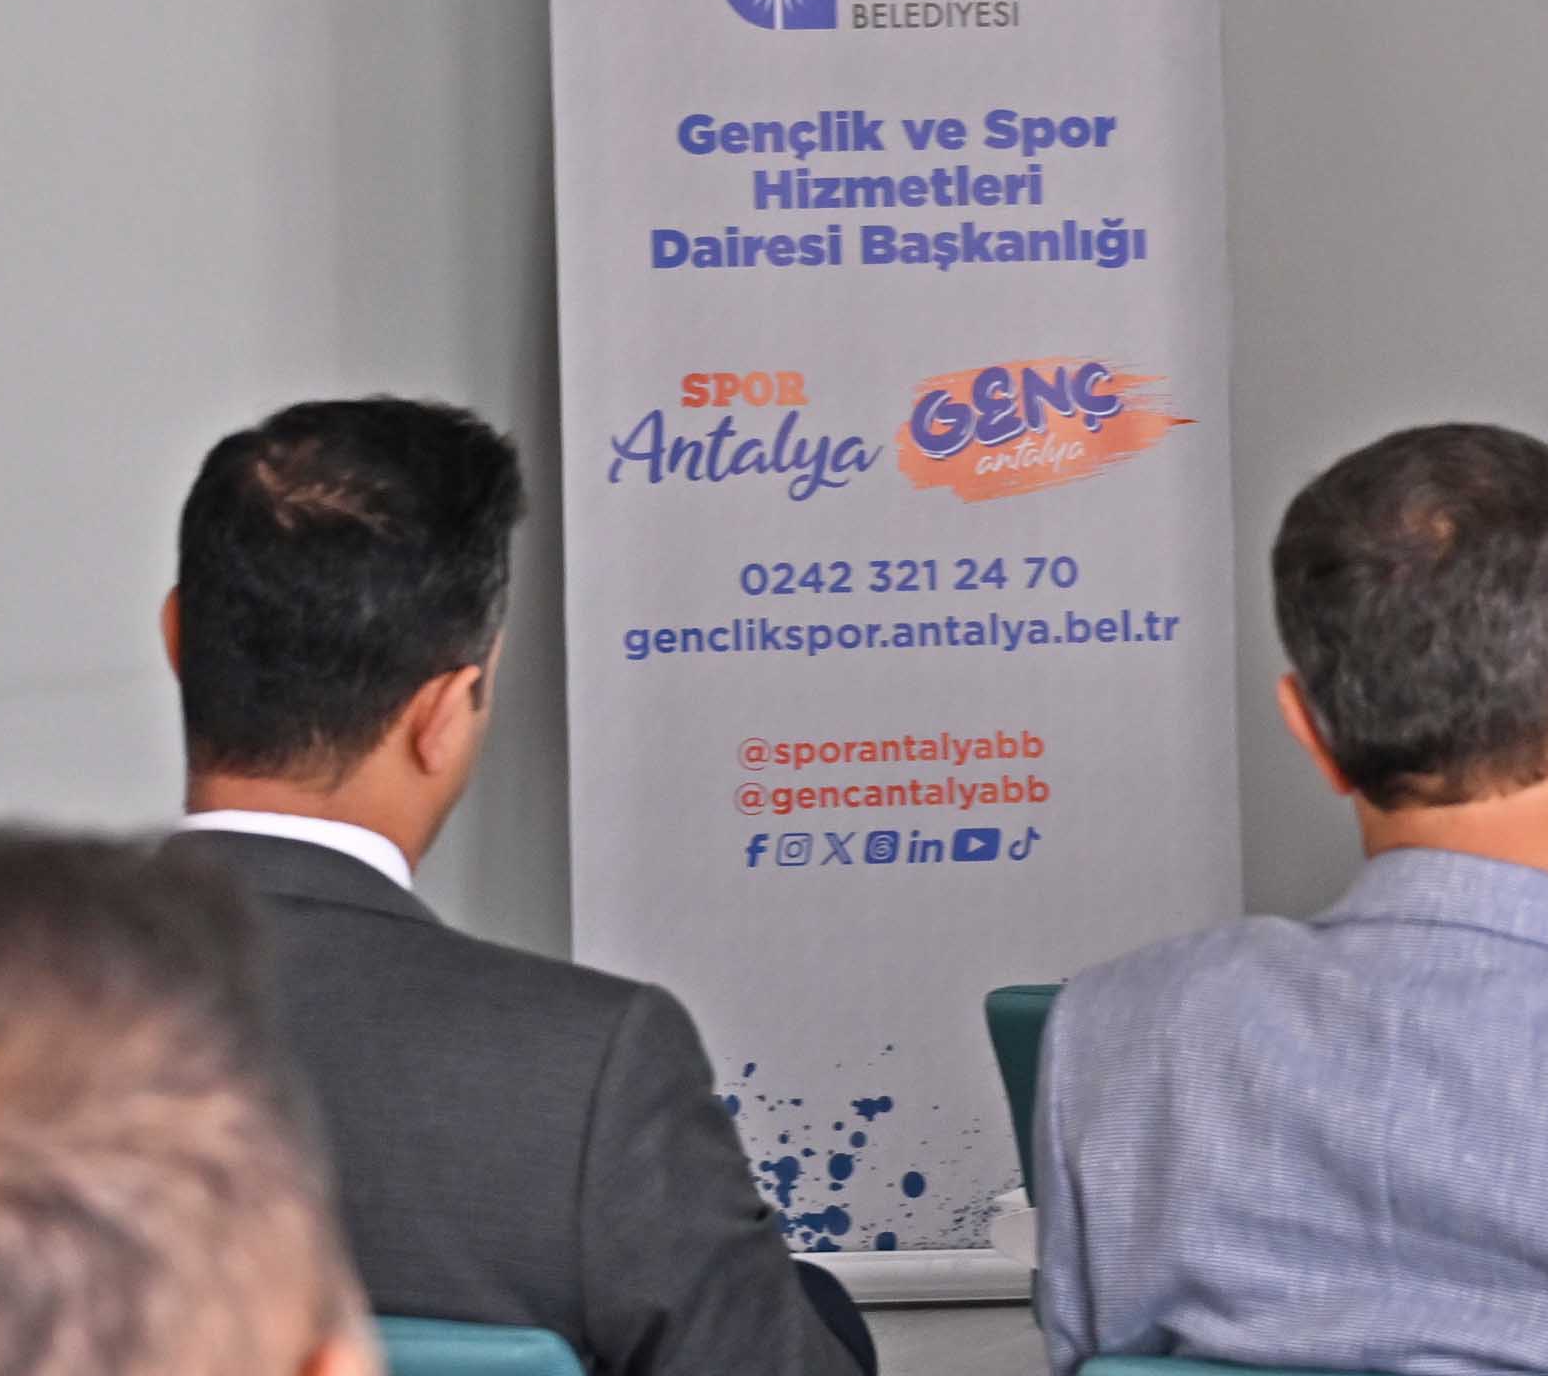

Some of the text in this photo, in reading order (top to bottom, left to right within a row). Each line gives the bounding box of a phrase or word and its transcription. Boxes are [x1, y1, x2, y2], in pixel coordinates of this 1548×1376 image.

[677, 109, 1118, 161] Gençlik ve Spor
[753, 164, 1043, 210] Hizmetleri
[652, 218, 1147, 271] Dairesi Başkanlığı
[681, 370, 809, 408] SPOR
[910, 362, 1124, 459] GENÇ
[608, 410, 883, 501] Antalya
[975, 438, 1084, 475] antalya
[739, 555, 1080, 597] 0242 321 24 70
[623, 609, 1179, 661] genclikspor.antalya.bel.tr
[738, 730, 1045, 771] @sporantalyabb
[734, 774, 1051, 816] @gencantalyabb
